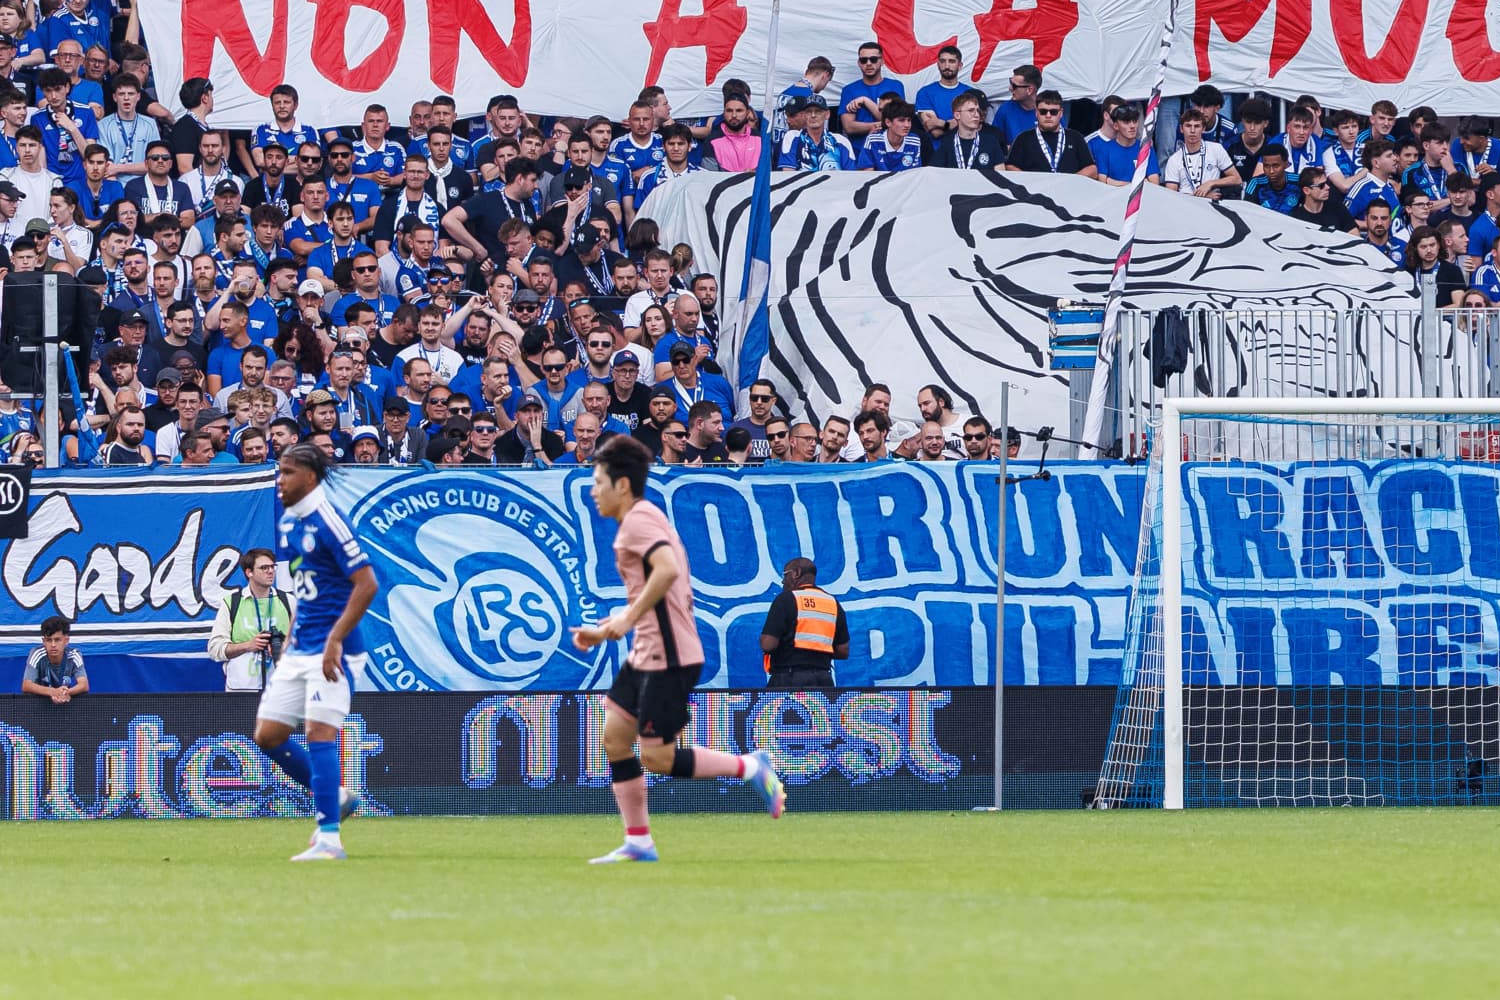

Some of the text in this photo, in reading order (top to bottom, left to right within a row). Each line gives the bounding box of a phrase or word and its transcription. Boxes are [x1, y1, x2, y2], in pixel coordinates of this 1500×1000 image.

[370, 490, 440, 535] RACING
[444, 488, 501, 512] CLUB
[504, 503, 531, 528] DE
[986, 473, 1150, 577] UN
[4, 490, 242, 619] Garde
[803, 597, 817, 609] 35
